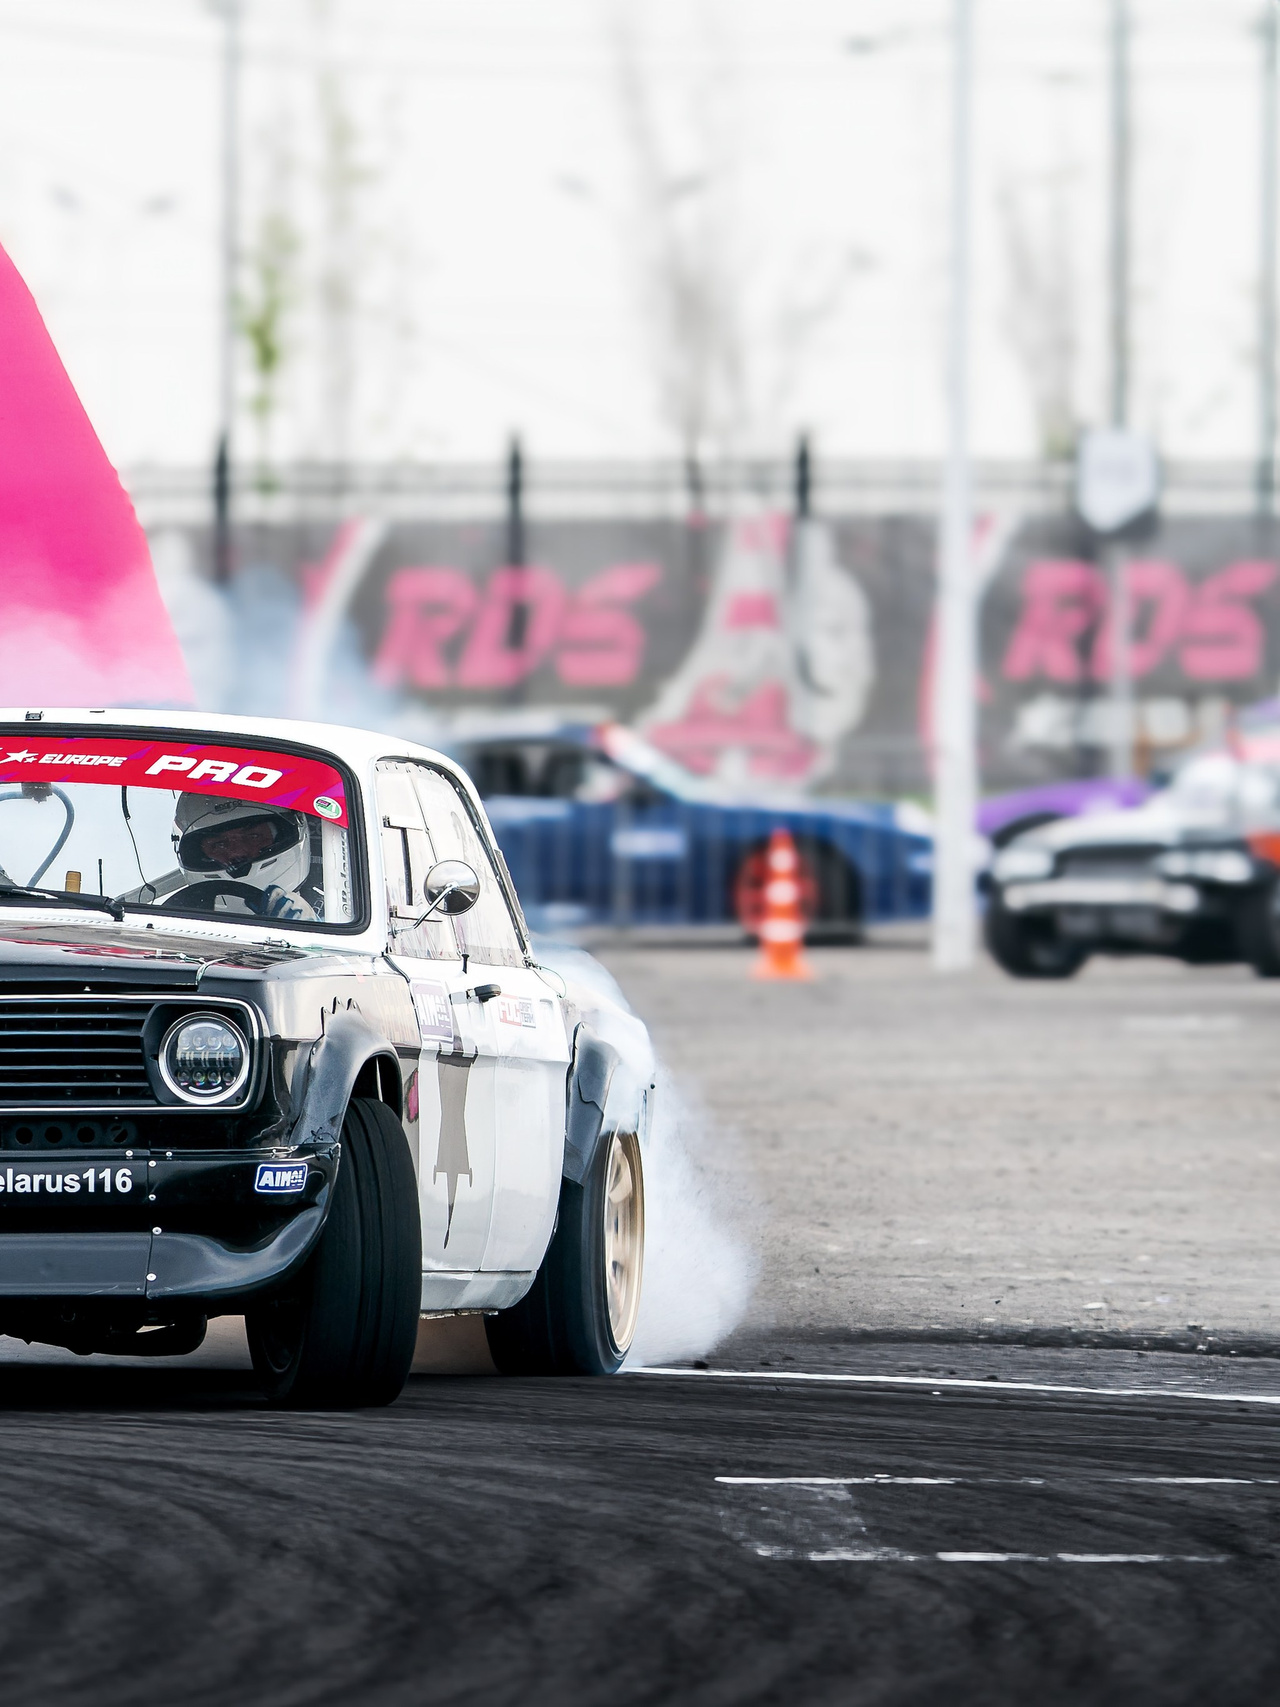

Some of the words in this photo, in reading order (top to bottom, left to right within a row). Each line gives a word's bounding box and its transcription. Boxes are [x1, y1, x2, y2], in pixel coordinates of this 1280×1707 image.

[373, 562, 665, 688] RDS
[1002, 558, 1280, 681] RDS
[38, 753, 128, 768] EUROPE
[144, 754, 284, 789] PRO
[258, 1170, 303, 1186] AIMOL
